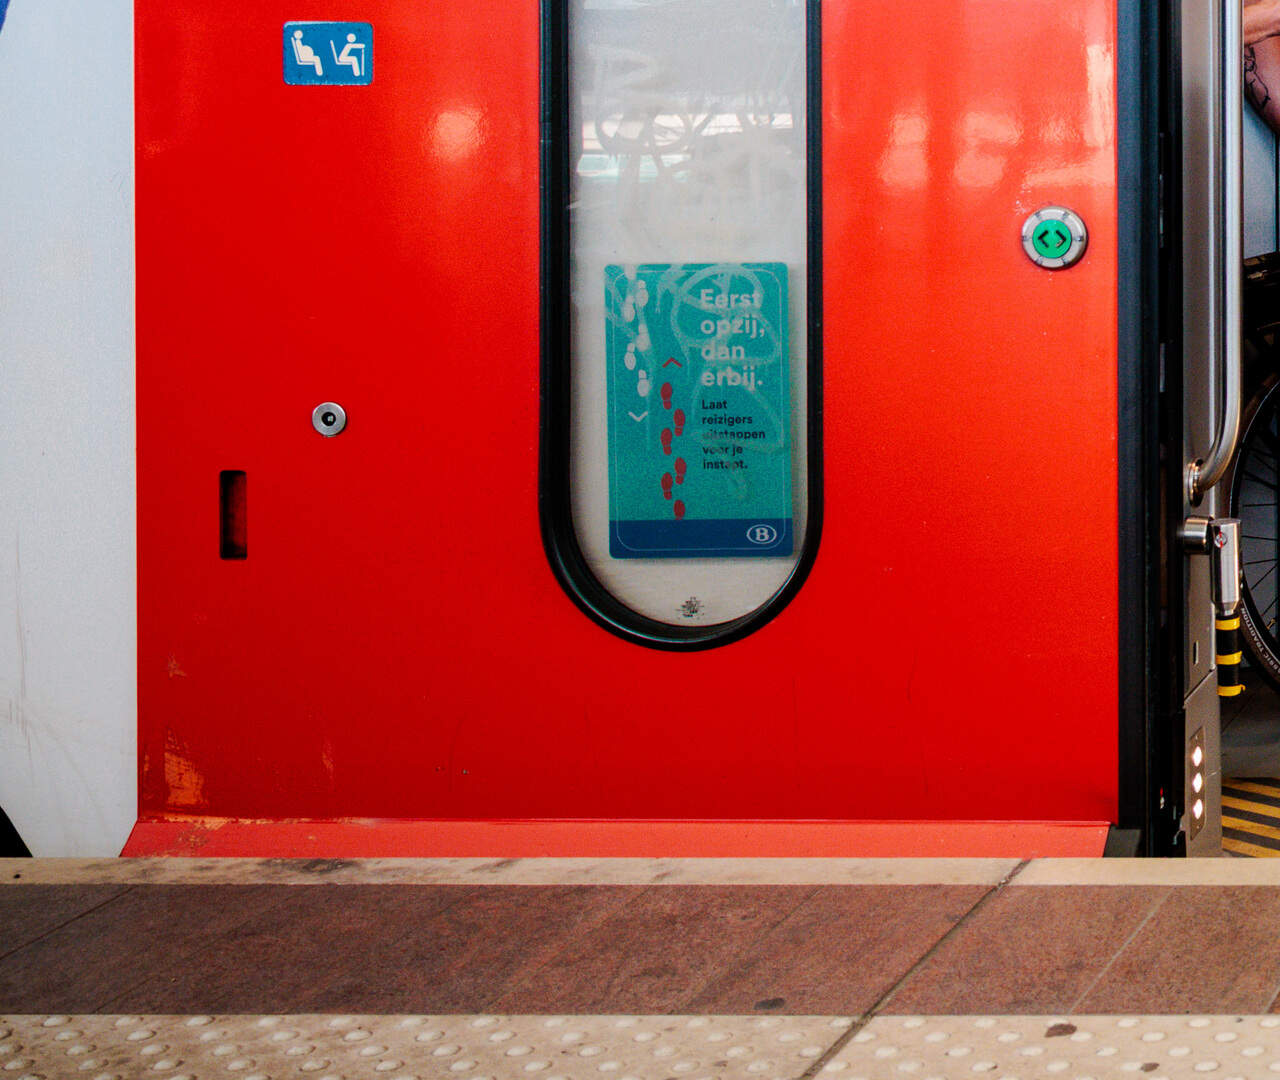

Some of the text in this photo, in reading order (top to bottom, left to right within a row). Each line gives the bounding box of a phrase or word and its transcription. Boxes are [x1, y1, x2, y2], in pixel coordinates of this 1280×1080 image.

[701, 288, 762, 308] Eerst
[701, 314, 765, 339] opzij,
[701, 340, 745, 360] dan
[701, 366, 763, 391] erbij.
[702, 400, 727, 409] Laat
[702, 414, 753, 426] reizigers
[733, 444, 743, 456] je
[756, 527, 769, 541] B
[1240, 607, 1265, 654] TRADITION
